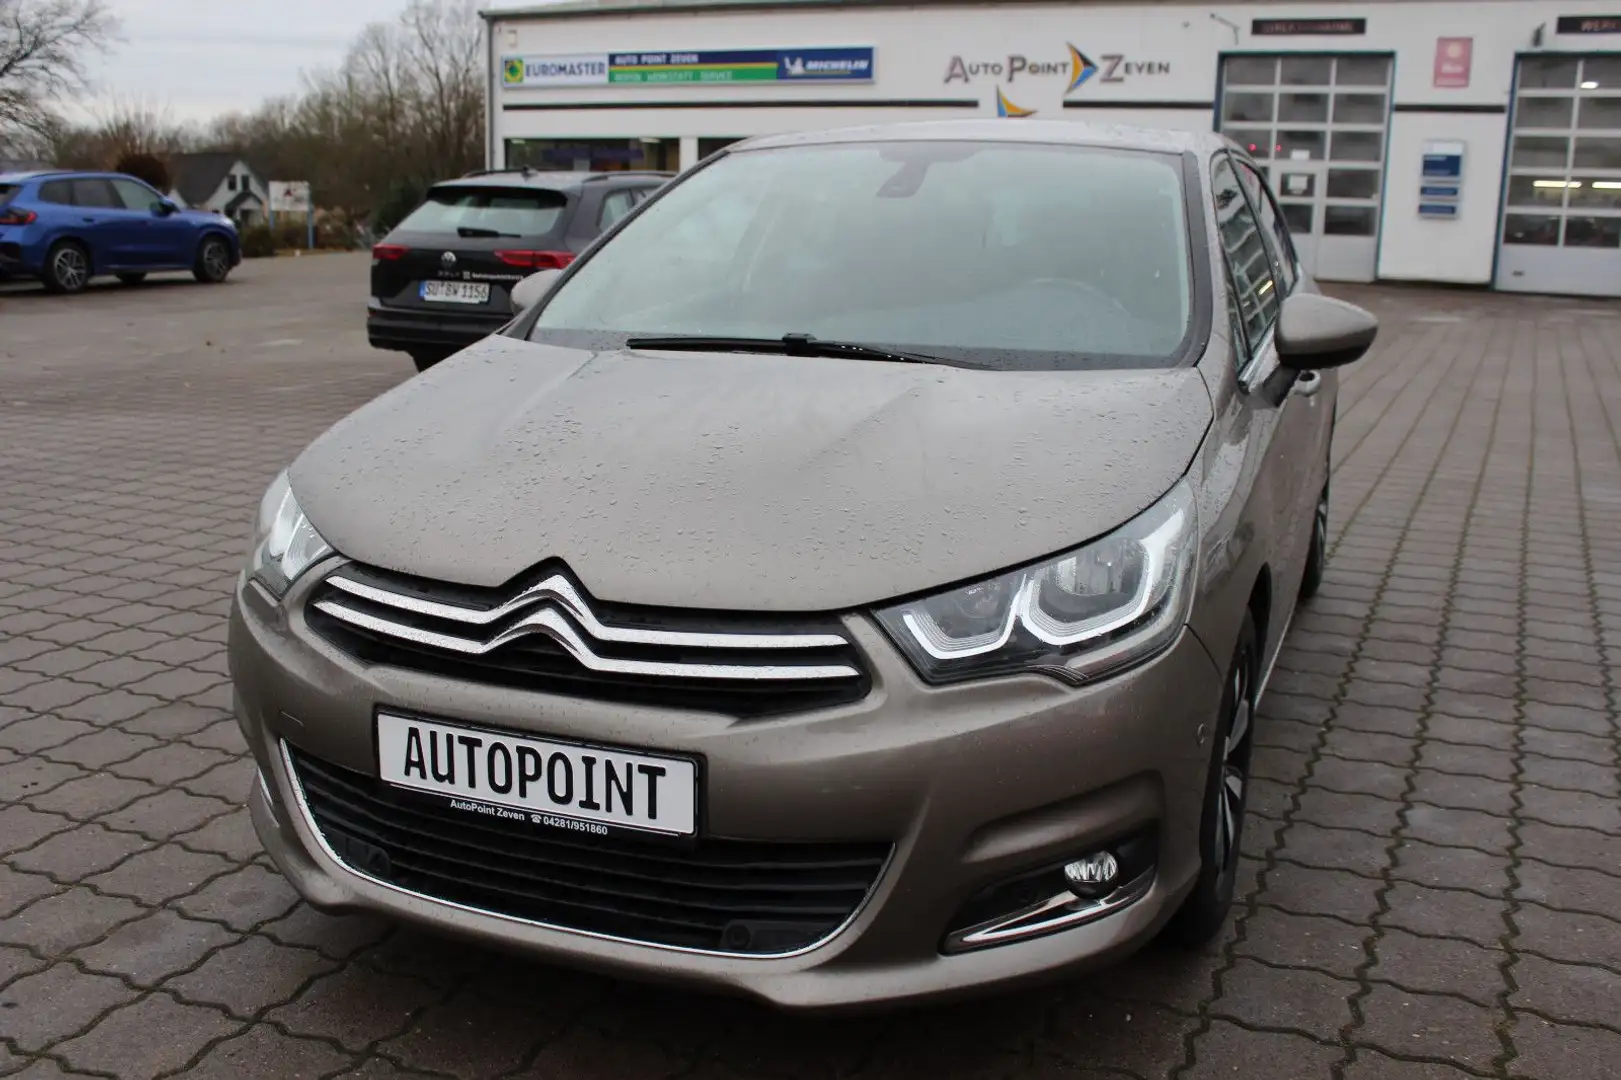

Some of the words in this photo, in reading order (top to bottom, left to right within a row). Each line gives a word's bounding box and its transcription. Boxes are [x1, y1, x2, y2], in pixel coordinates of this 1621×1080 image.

[525, 62, 605, 77] EUROMASTER
[615, 55, 638, 65] AUTO
[641, 54, 667, 65] POINT
[670, 53, 699, 64] ZEVEN
[805, 59, 870, 71] MICHELIN
[944, 56, 1003, 84] AUTO
[1007, 54, 1071, 83] POINT
[1100, 54, 1171, 83] ZEVEN
[404, 726, 666, 820] AUTOPOINT
[450, 799, 496, 816] AutoPoint
[496, 807, 525, 821] Zeven
[543, 816, 608, 835] 04281/951860
